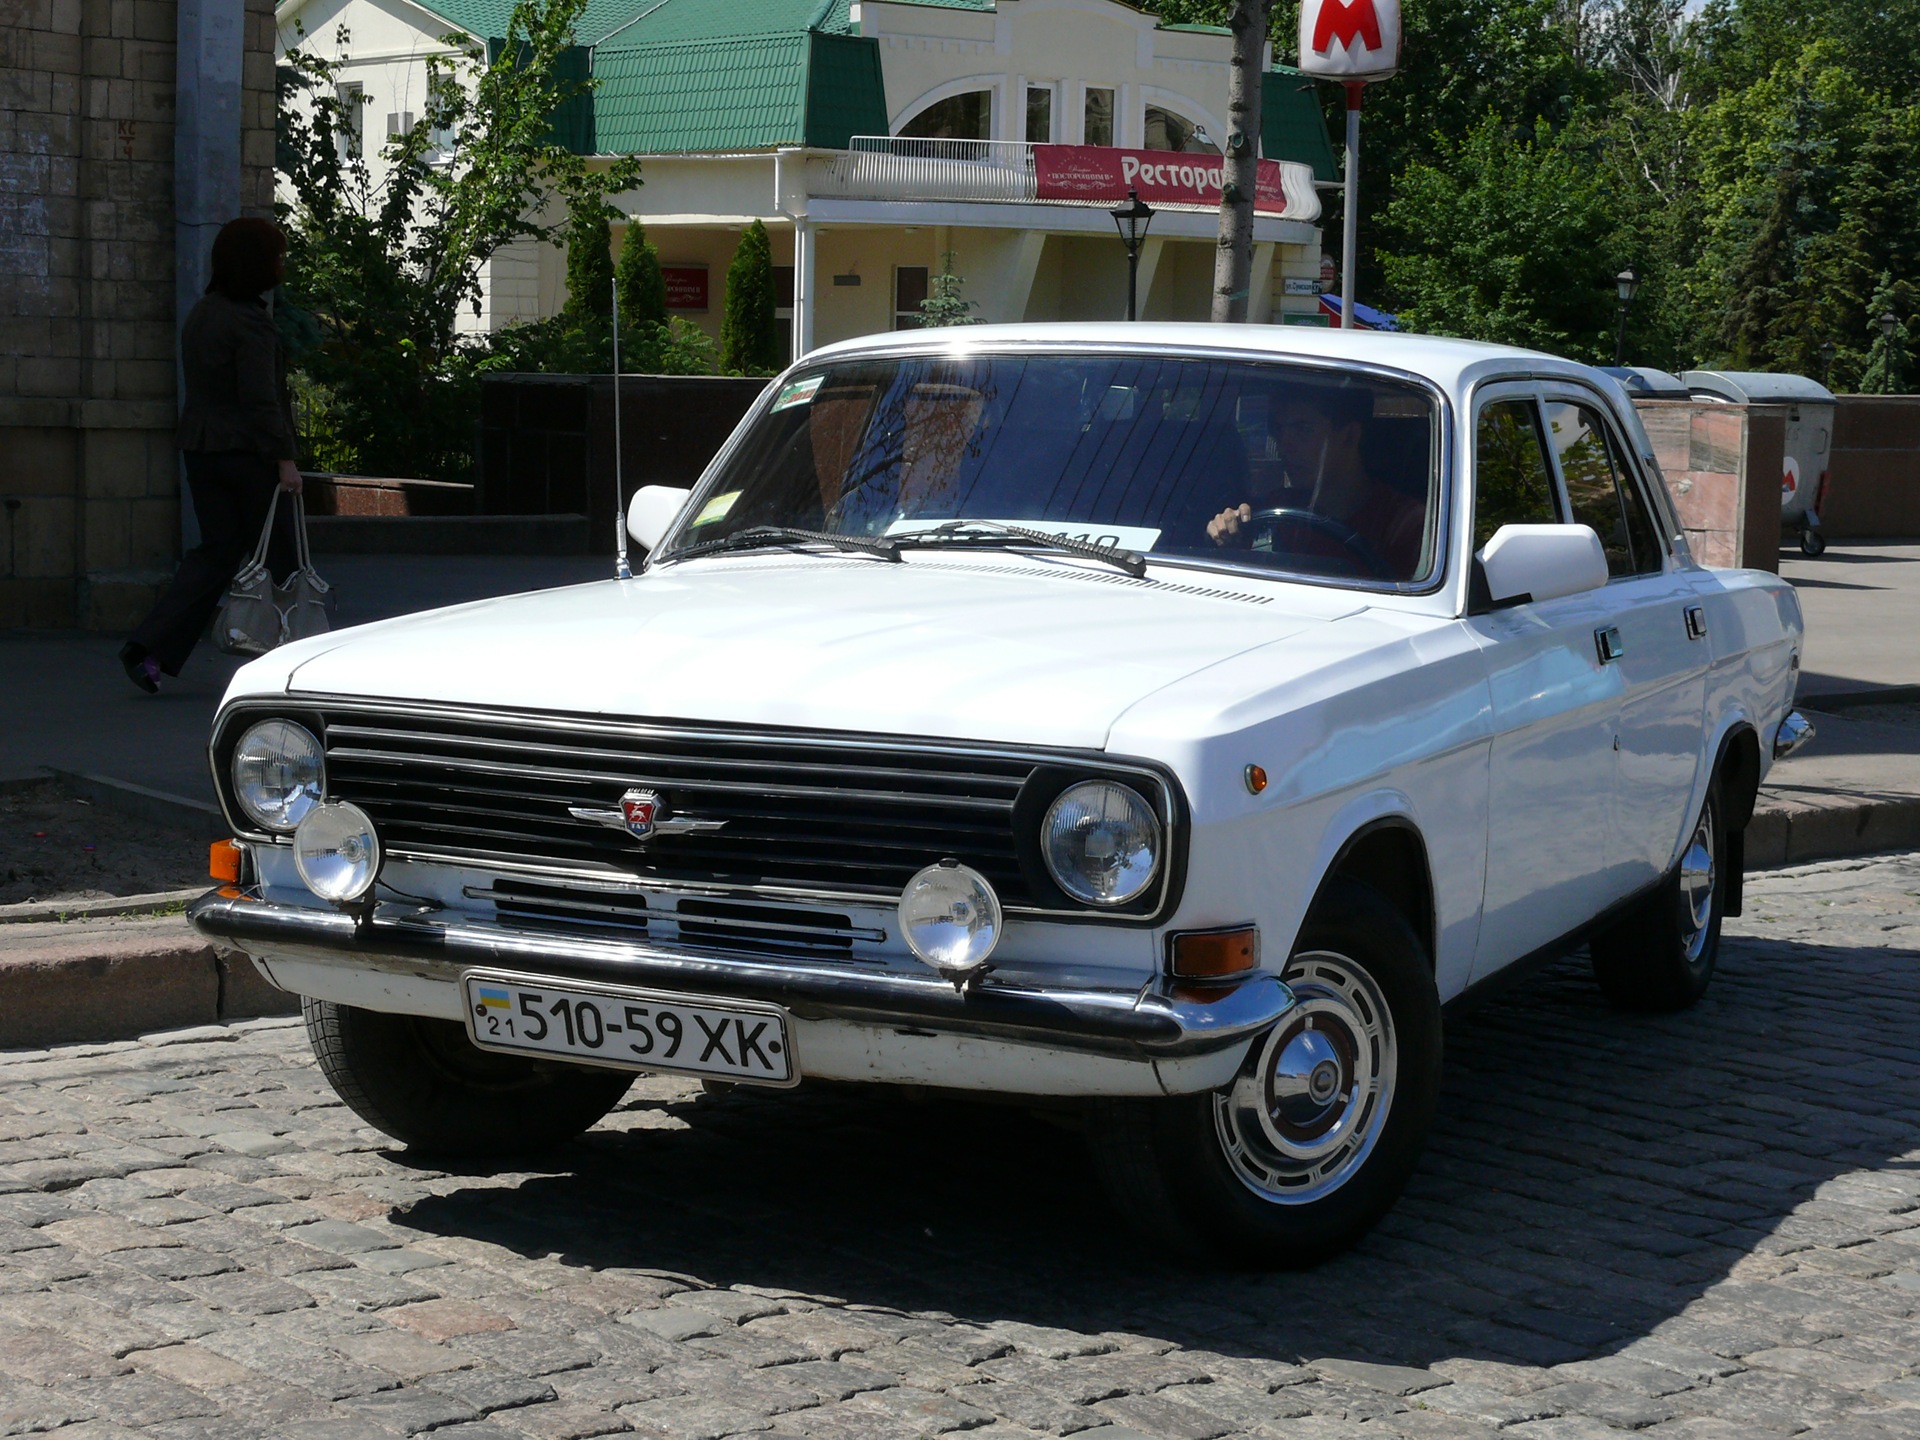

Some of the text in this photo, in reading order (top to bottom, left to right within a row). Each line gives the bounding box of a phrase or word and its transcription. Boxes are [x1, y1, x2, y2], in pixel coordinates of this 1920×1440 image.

[1312, 0, 1382, 53] М
[1121, 156, 1224, 194] Рестора
[487, 1016, 515, 1037] 21
